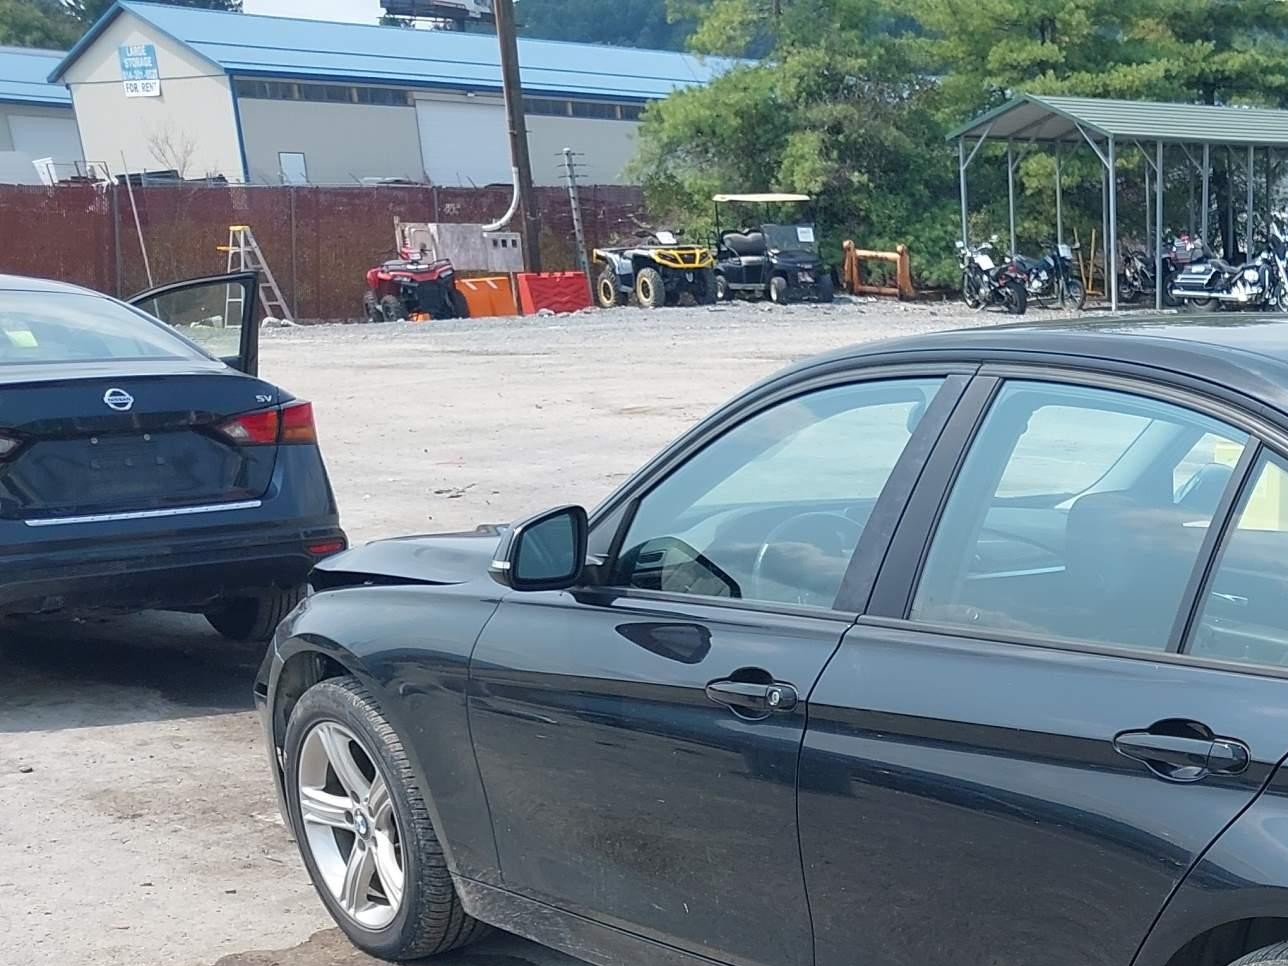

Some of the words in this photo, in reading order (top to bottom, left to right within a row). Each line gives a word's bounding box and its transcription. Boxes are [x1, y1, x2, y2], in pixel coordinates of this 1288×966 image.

[125, 82, 139, 94] FOR
[141, 81, 157, 93] RENT
[255, 394, 272, 402] SV
